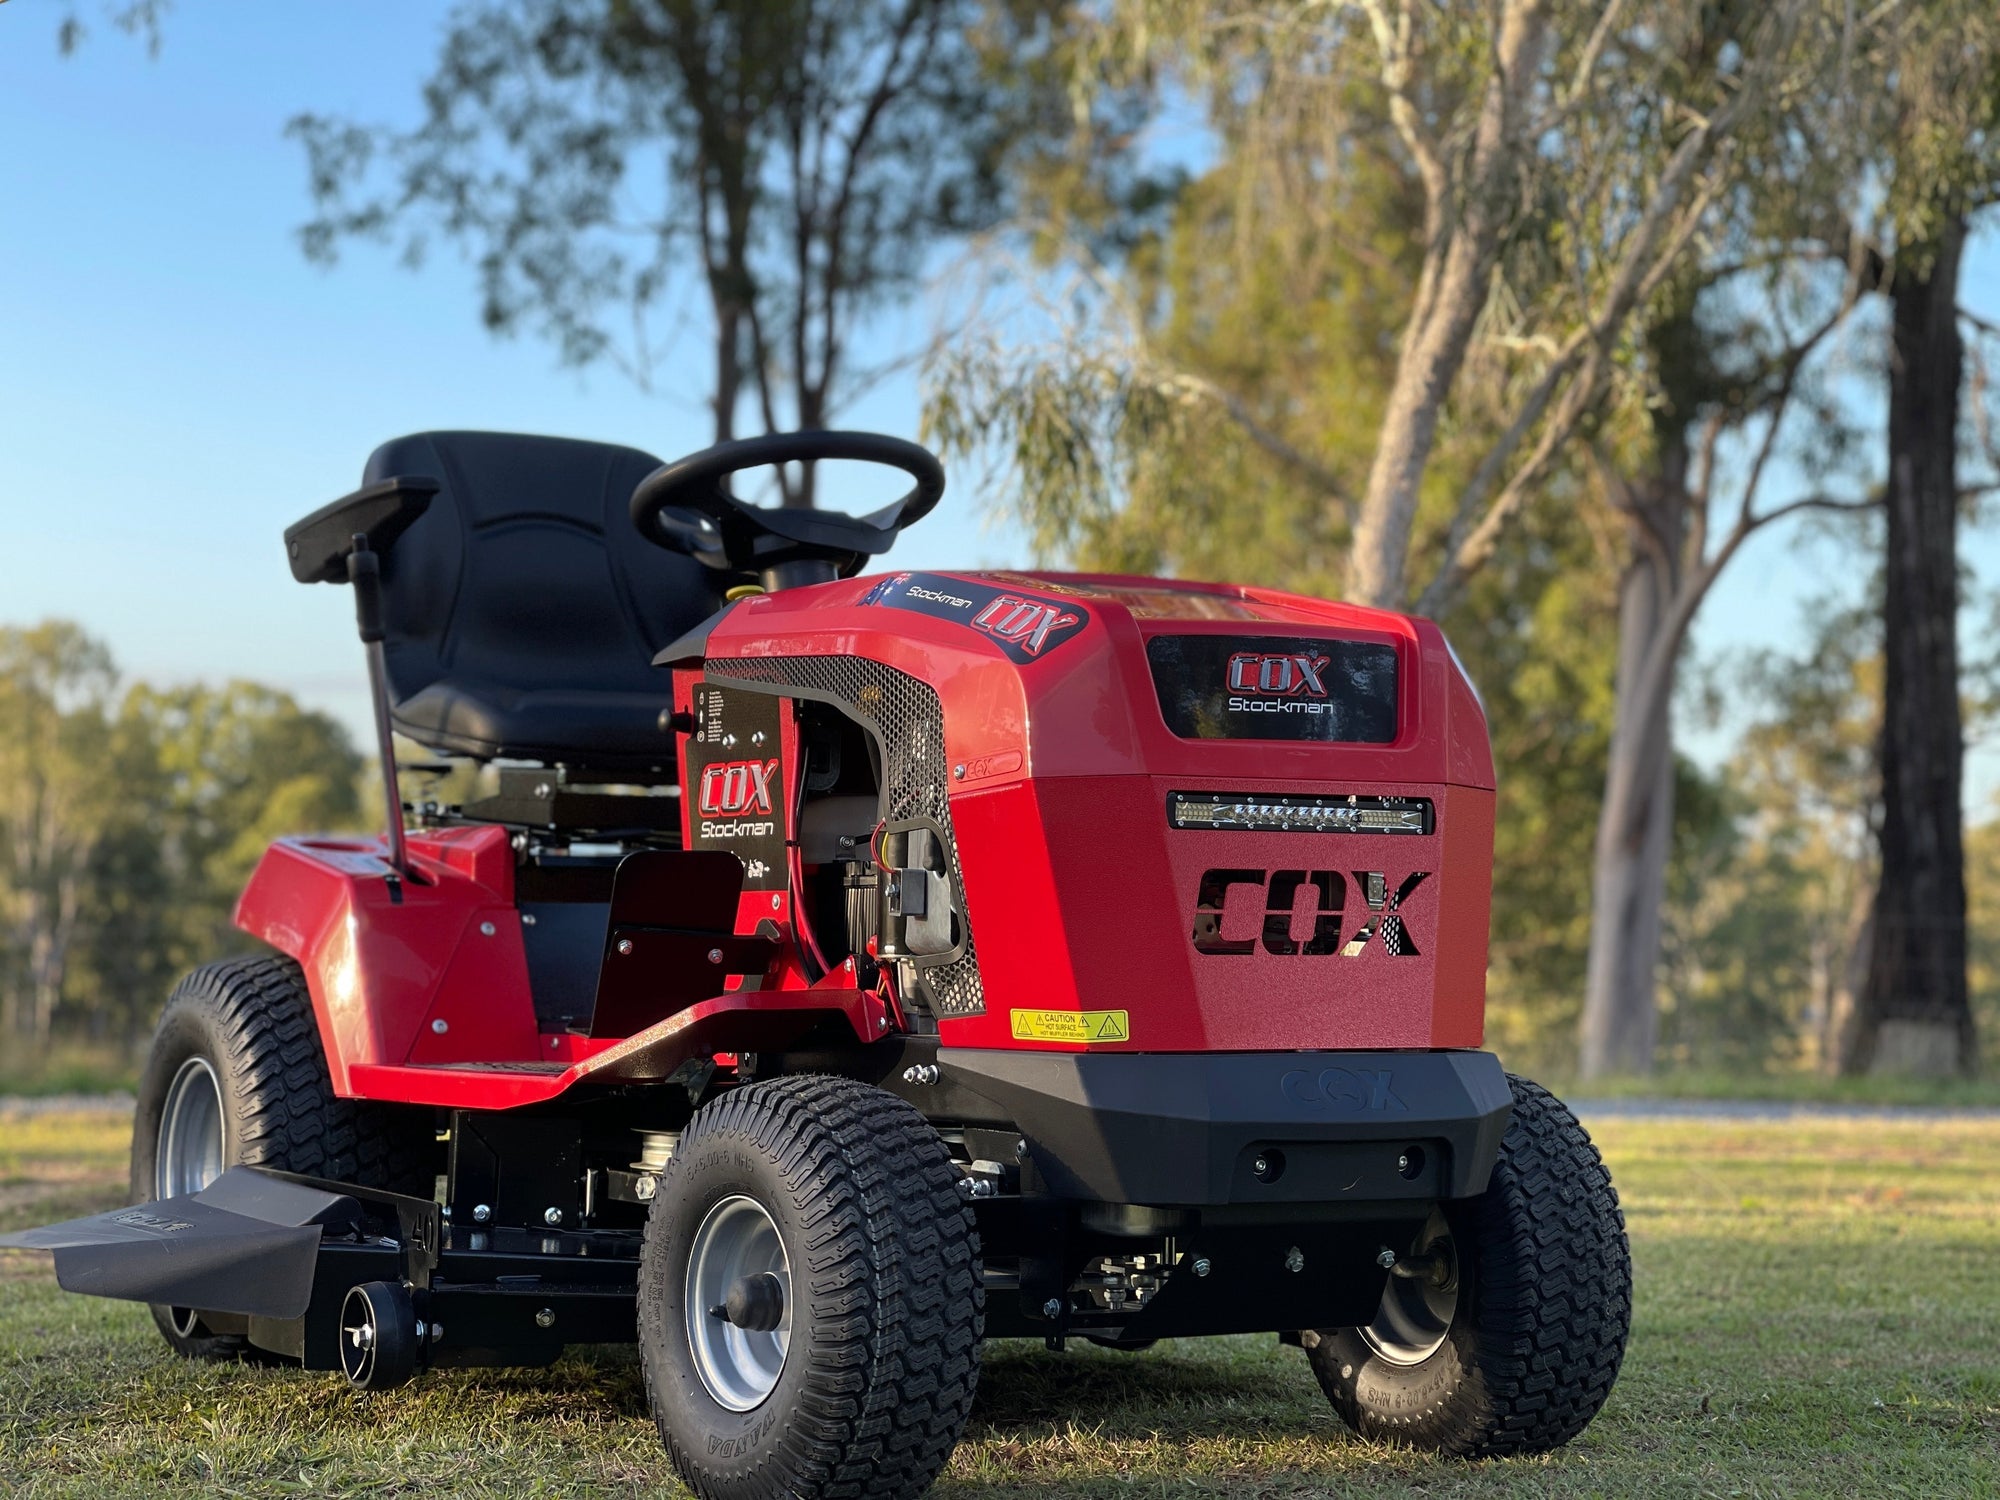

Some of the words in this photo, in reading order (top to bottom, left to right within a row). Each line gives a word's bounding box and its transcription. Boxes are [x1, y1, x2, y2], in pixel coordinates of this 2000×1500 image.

[906, 586, 972, 609] Stockman
[973, 595, 1077, 653] COX
[1228, 654, 1330, 695] COX
[1228, 698, 1333, 714] Stockman
[700, 760, 777, 815] COX
[701, 819, 774, 838] Stockman
[1192, 868, 1432, 956] COX
[1044, 1013, 1075, 1023] CAUTION
[1281, 1067, 1409, 1112] COX
[412, 1213, 434, 1254] 40
[1367, 1387, 1391, 1408] NHS
[707, 1407, 776, 1458] WANDA
